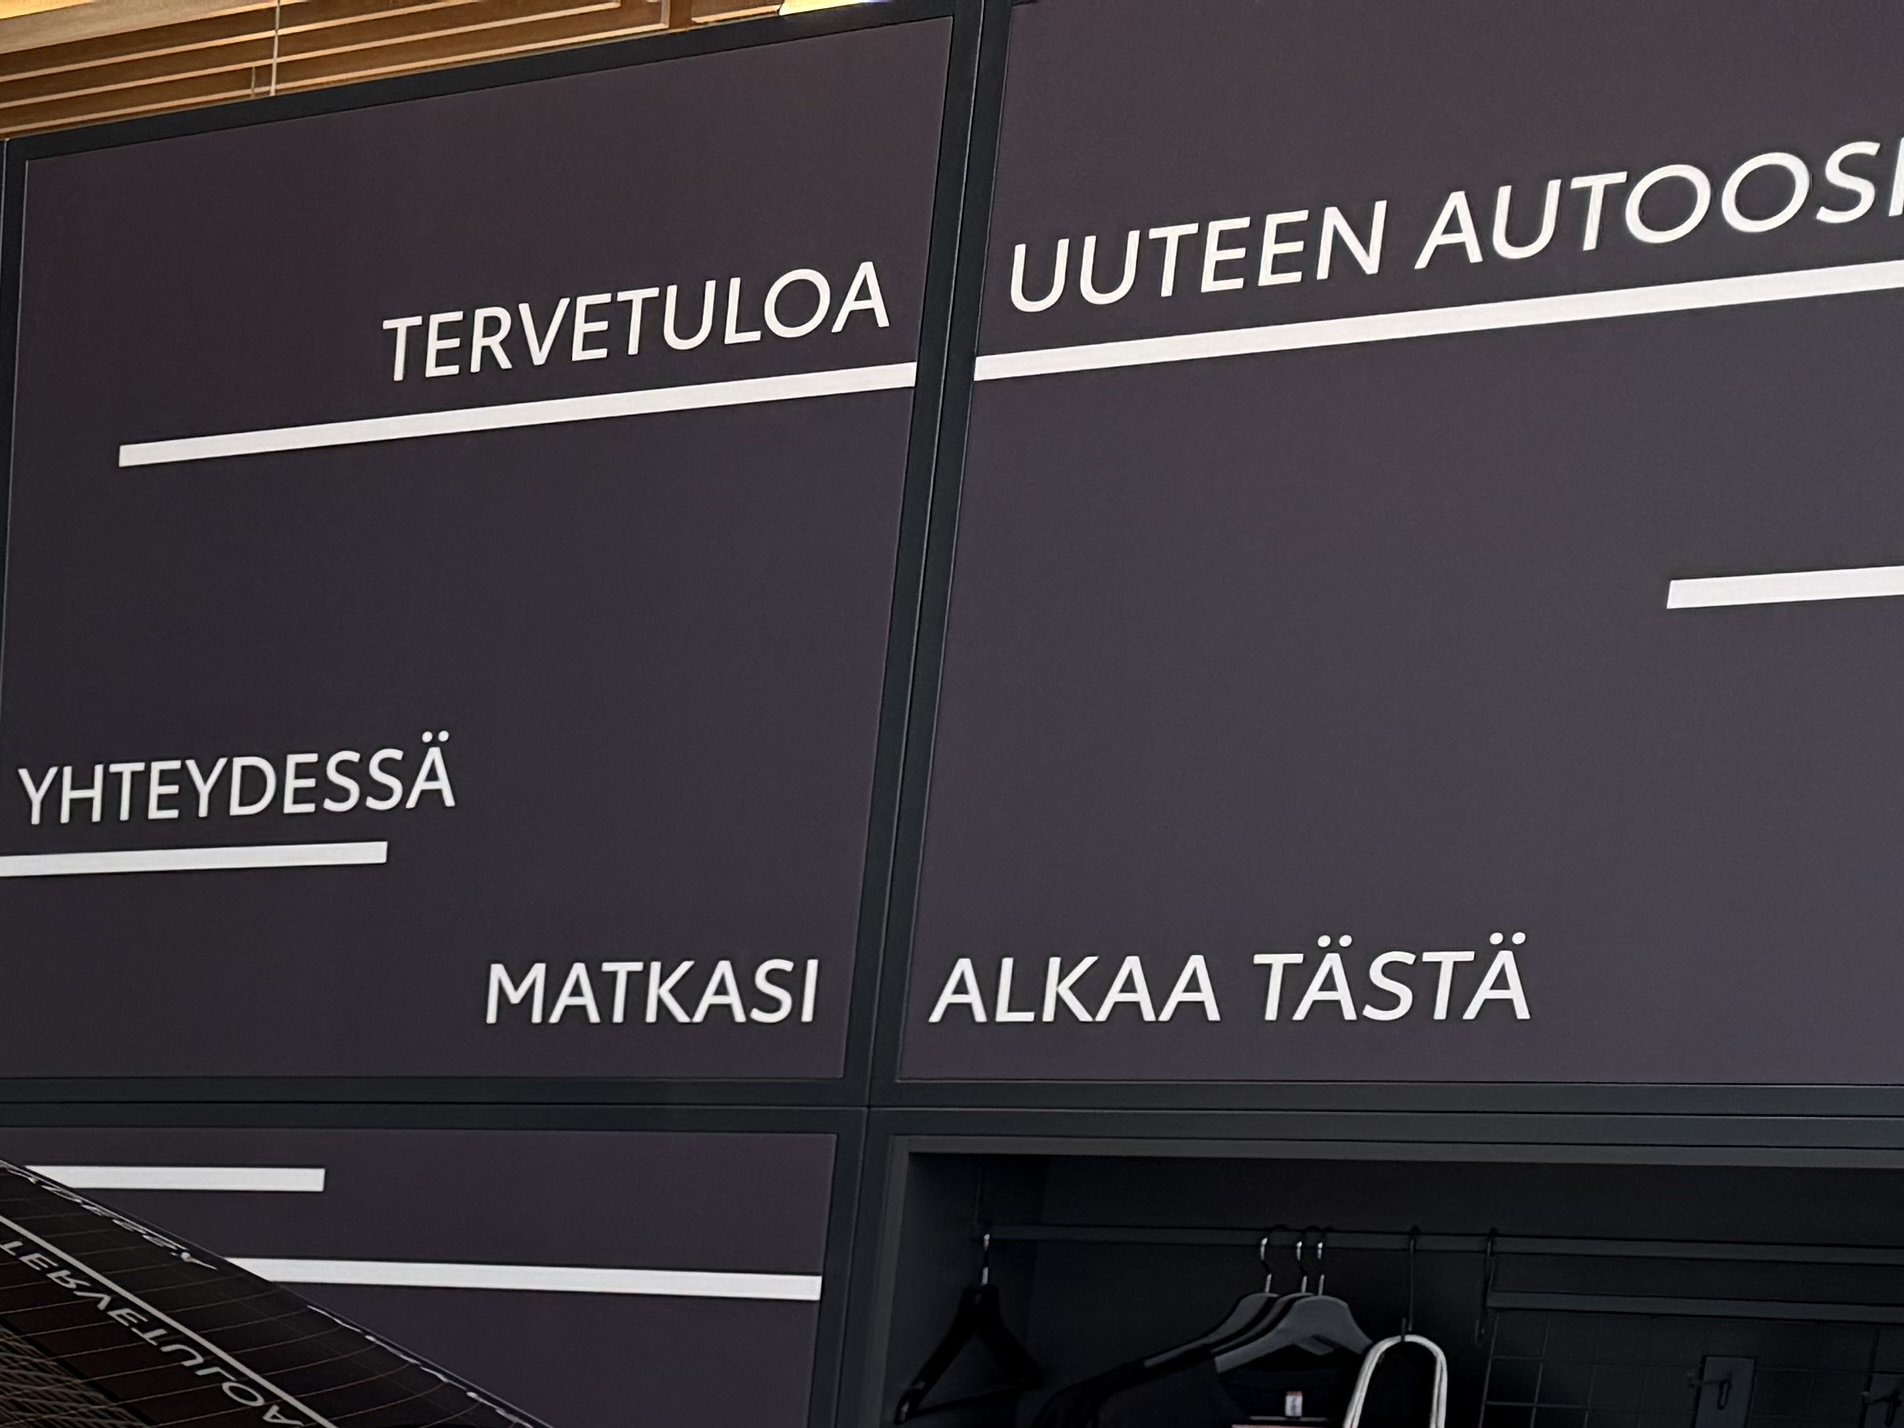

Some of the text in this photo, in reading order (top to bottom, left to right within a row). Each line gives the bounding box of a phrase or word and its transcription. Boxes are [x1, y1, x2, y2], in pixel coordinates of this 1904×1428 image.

[383, 262, 891, 381] TERVETULOA
[1011, 200, 1388, 312] UUTEEN
[18, 731, 456, 825] YHTEYDESSÄ
[486, 931, 1532, 1024] MATKASI ALKAA TÄSTÄ
